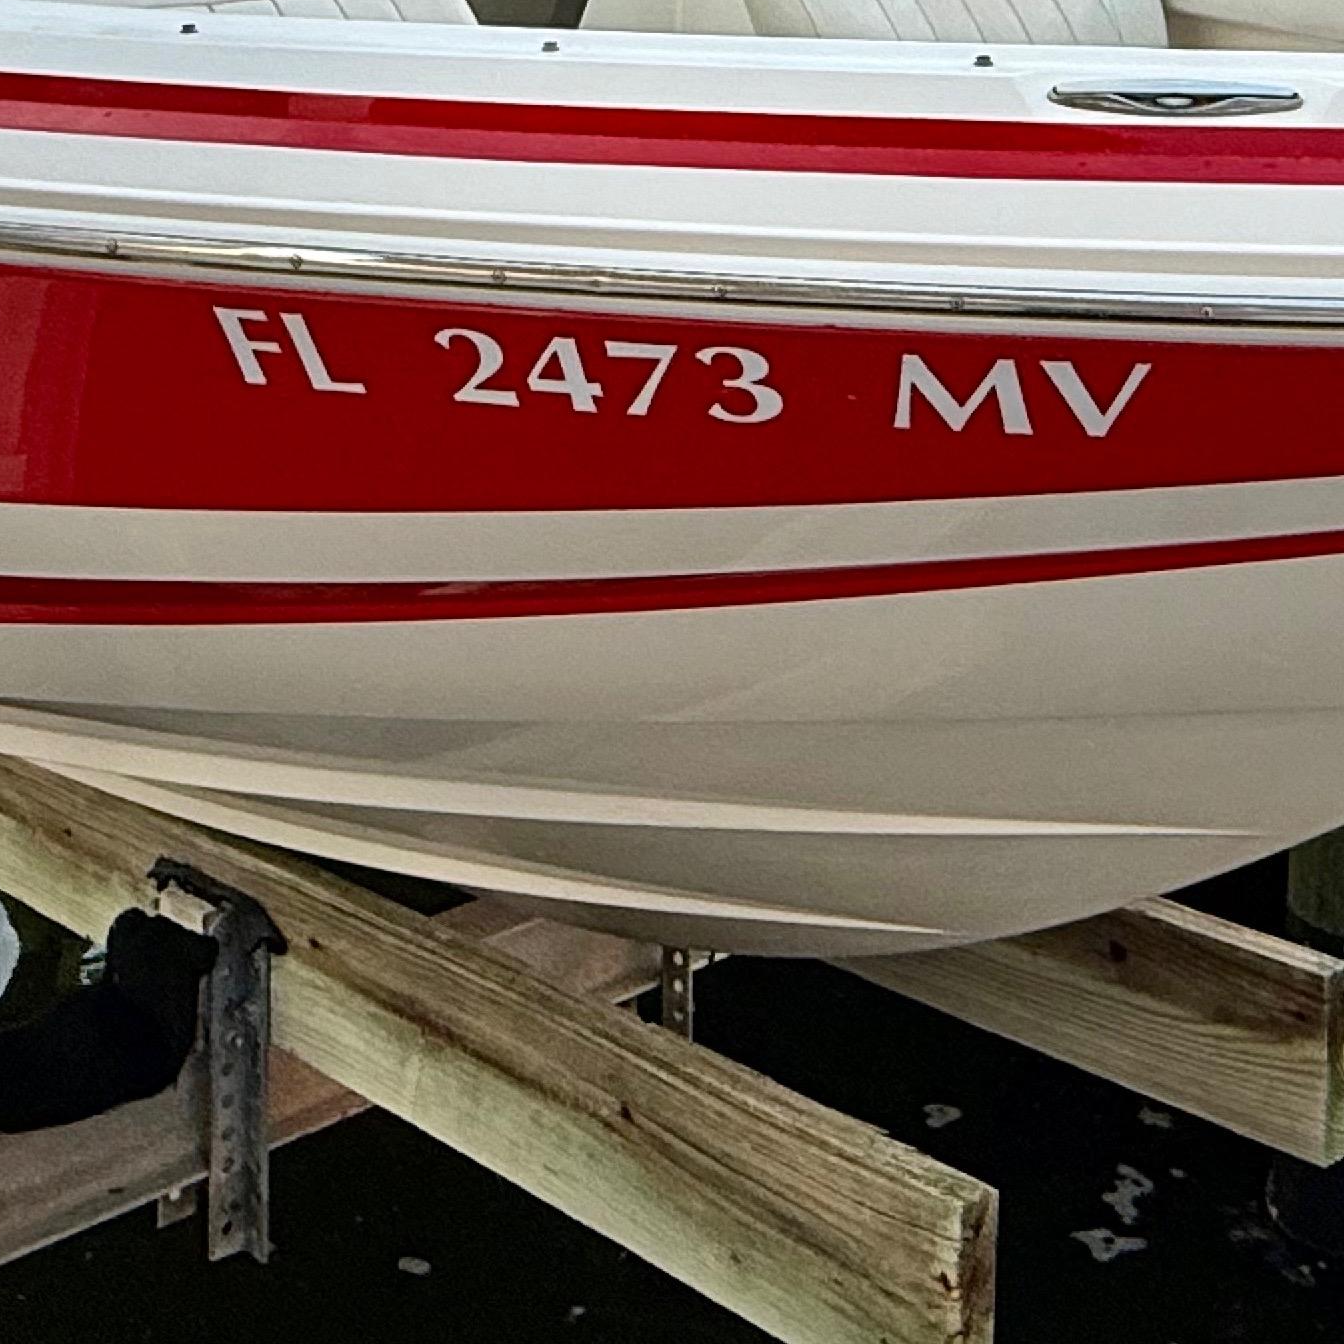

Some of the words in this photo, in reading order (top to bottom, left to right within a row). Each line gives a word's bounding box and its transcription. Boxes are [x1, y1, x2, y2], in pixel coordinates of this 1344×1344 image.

[212, 305, 367, 394] FL
[434, 328, 784, 424] 2473
[893, 354, 1152, 438] MV
